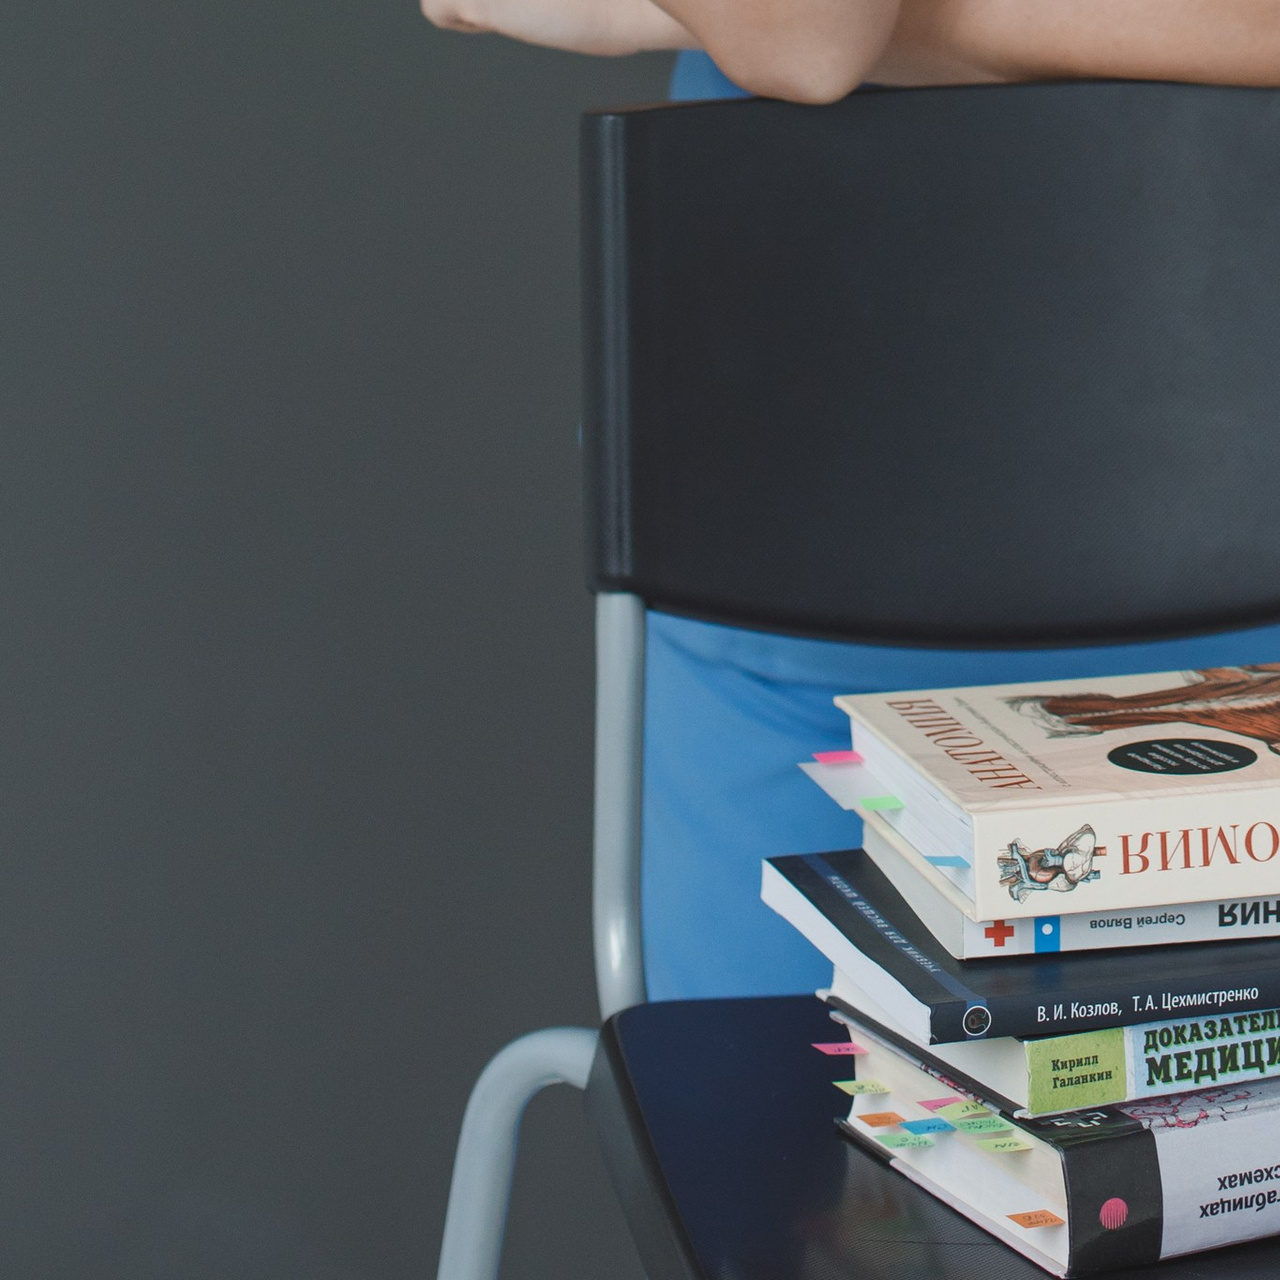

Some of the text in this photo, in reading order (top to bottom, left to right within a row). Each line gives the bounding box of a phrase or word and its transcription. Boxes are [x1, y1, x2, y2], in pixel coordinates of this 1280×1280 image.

[885, 698, 1043, 790] АНАТОМИЯ
[1090, 913, 1186, 929] Сергей Вялов
[1037, 987, 1259, 1022] В. И. Козлов, Т. А. Цехмистренко
[1051, 1055, 1099, 1072] Кирилл
[1052, 1069, 1113, 1089] Галанкин
